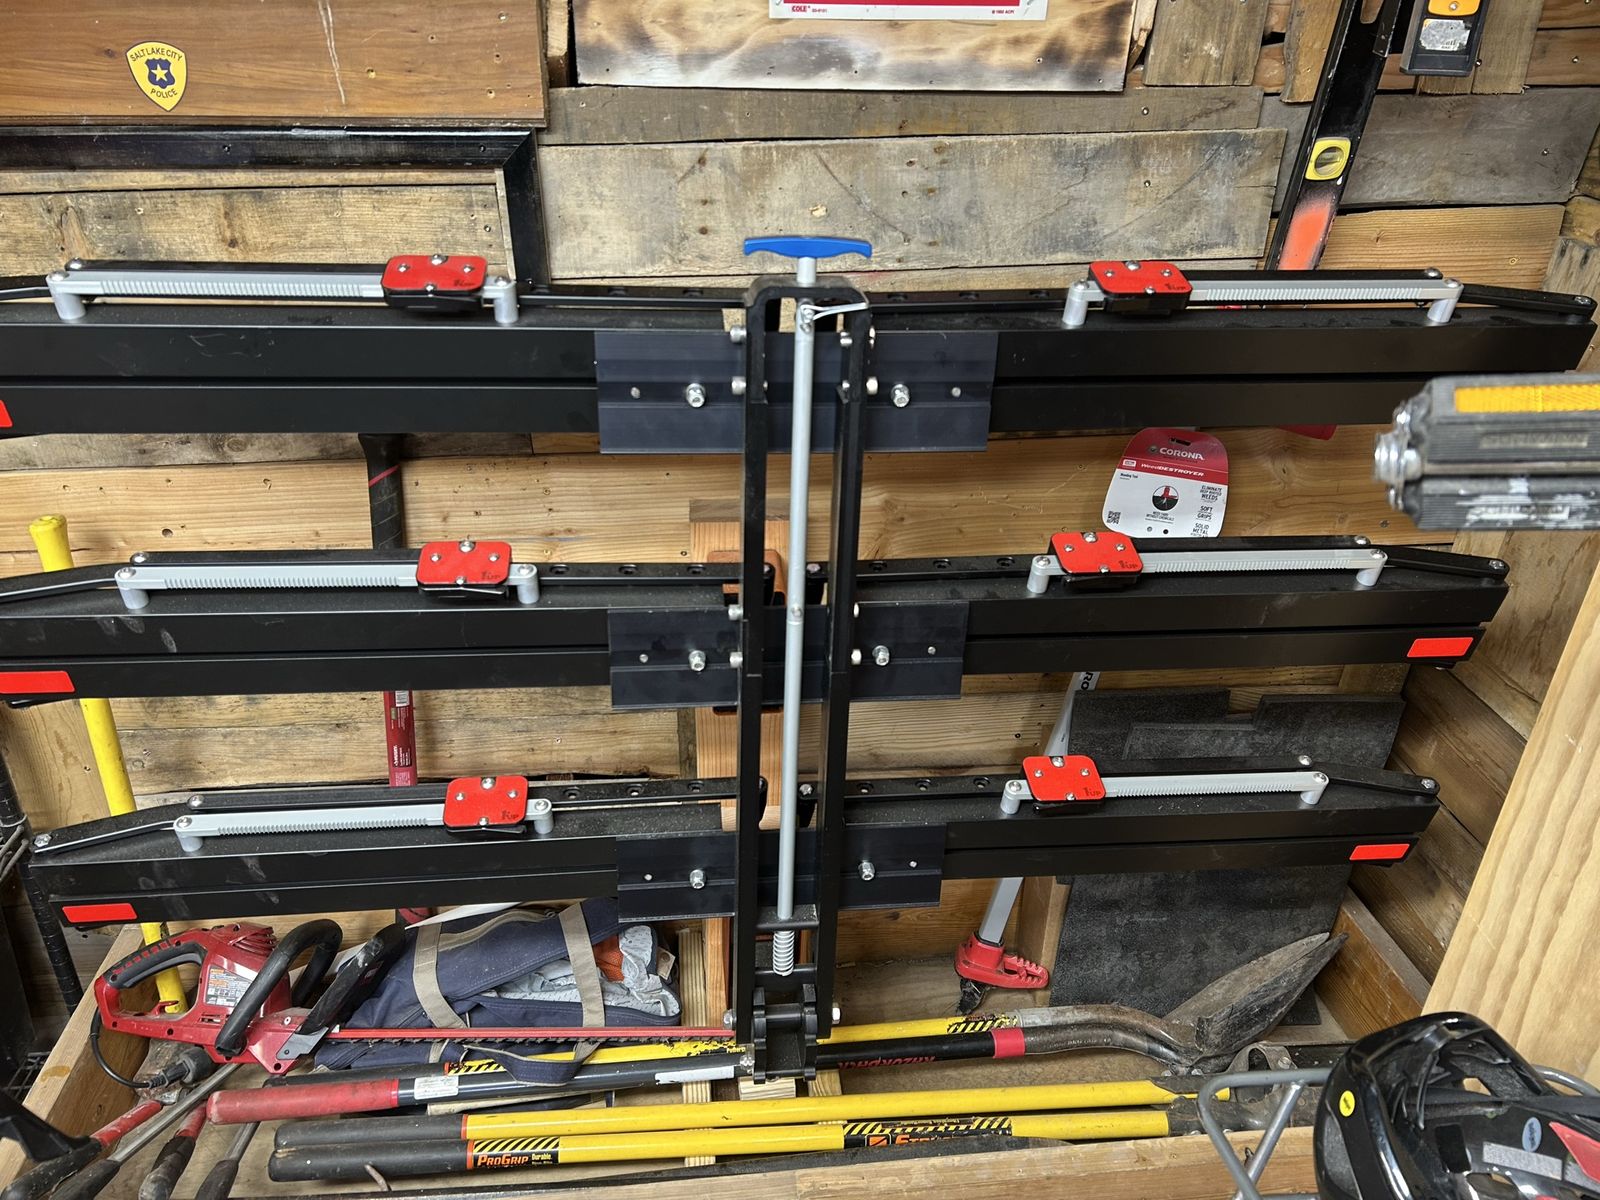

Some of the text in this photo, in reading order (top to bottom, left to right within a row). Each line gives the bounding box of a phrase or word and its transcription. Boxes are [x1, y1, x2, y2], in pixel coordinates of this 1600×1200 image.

[130, 47, 183, 61] SALT LAKE CITY
[150, 88, 178, 98] POLICE
[1159, 447, 1205, 461] CORONA
[1194, 522, 1209, 530] SOLID
